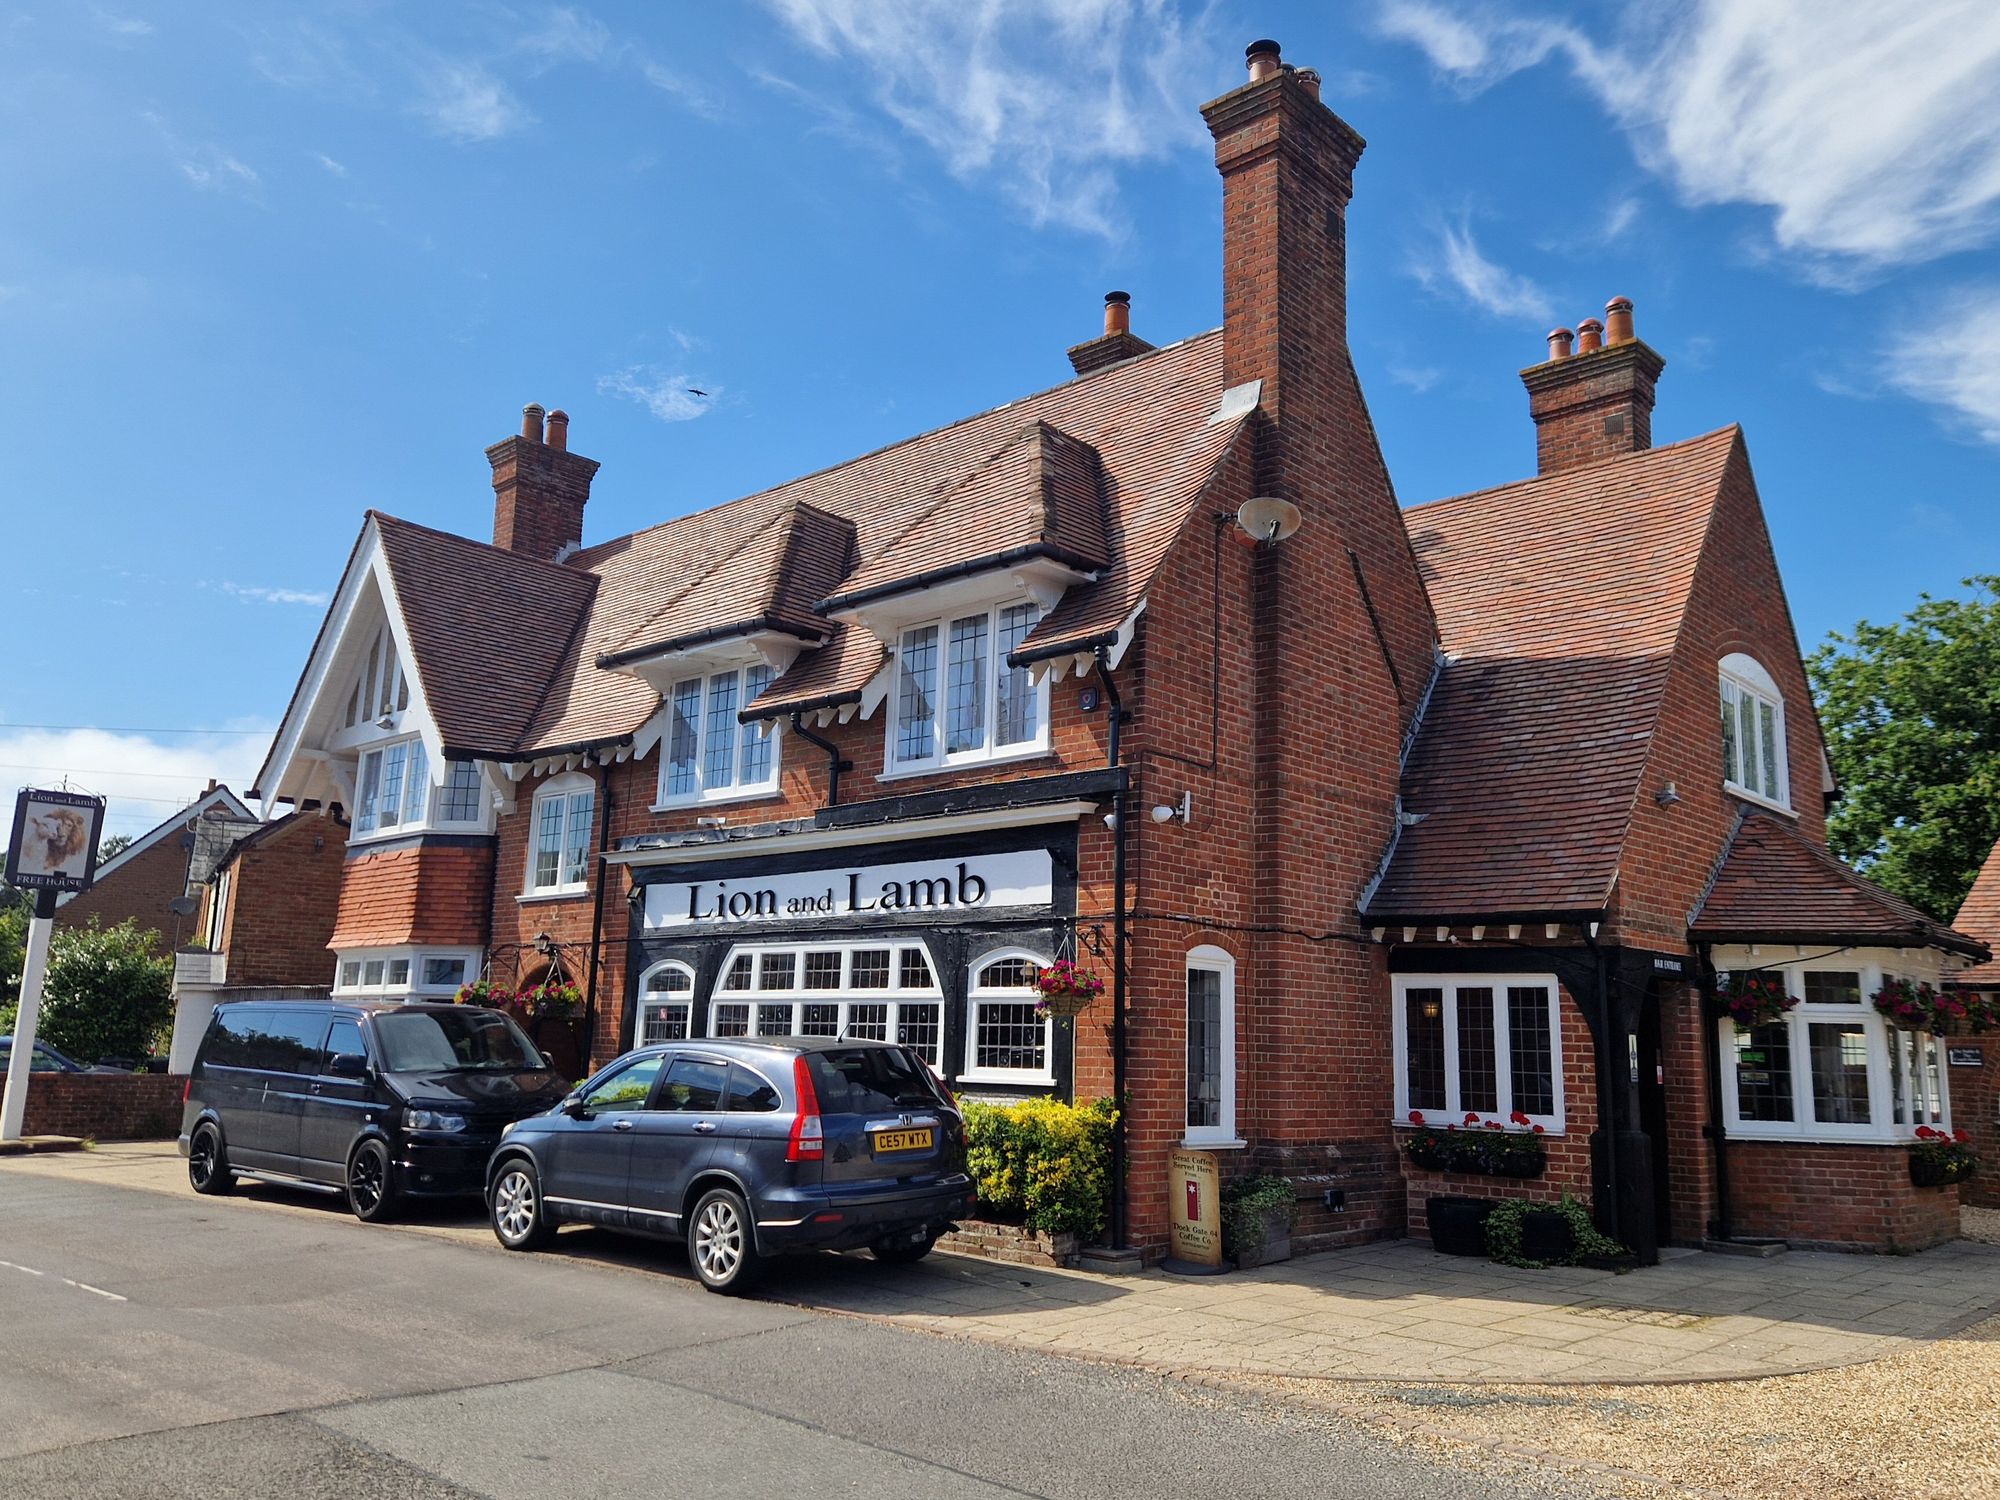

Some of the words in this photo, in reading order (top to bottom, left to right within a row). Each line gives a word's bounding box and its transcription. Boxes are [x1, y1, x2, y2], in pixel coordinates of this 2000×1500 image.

[29, 793, 54, 802] Lion
[68, 797, 97, 807] Lamb
[16, 875, 43, 885] FREE
[46, 877, 81, 887] HOUSE
[687, 881, 777, 920] Lion
[787, 888, 832, 913] and
[846, 862, 987, 911] Lamb
[879, 1135, 906, 1148] CE57
[908, 1132, 927, 1146] WTX
[1172, 1153, 1190, 1163] Great
[1192, 1157, 1213, 1166] Coffee
[1173, 1161, 1195, 1171] Served
[1196, 1165, 1212, 1174] Here
[1173, 1222, 1190, 1233] Dock
[1192, 1226, 1208, 1235] Gate
[1179, 1232, 1200, 1241] Coffee
